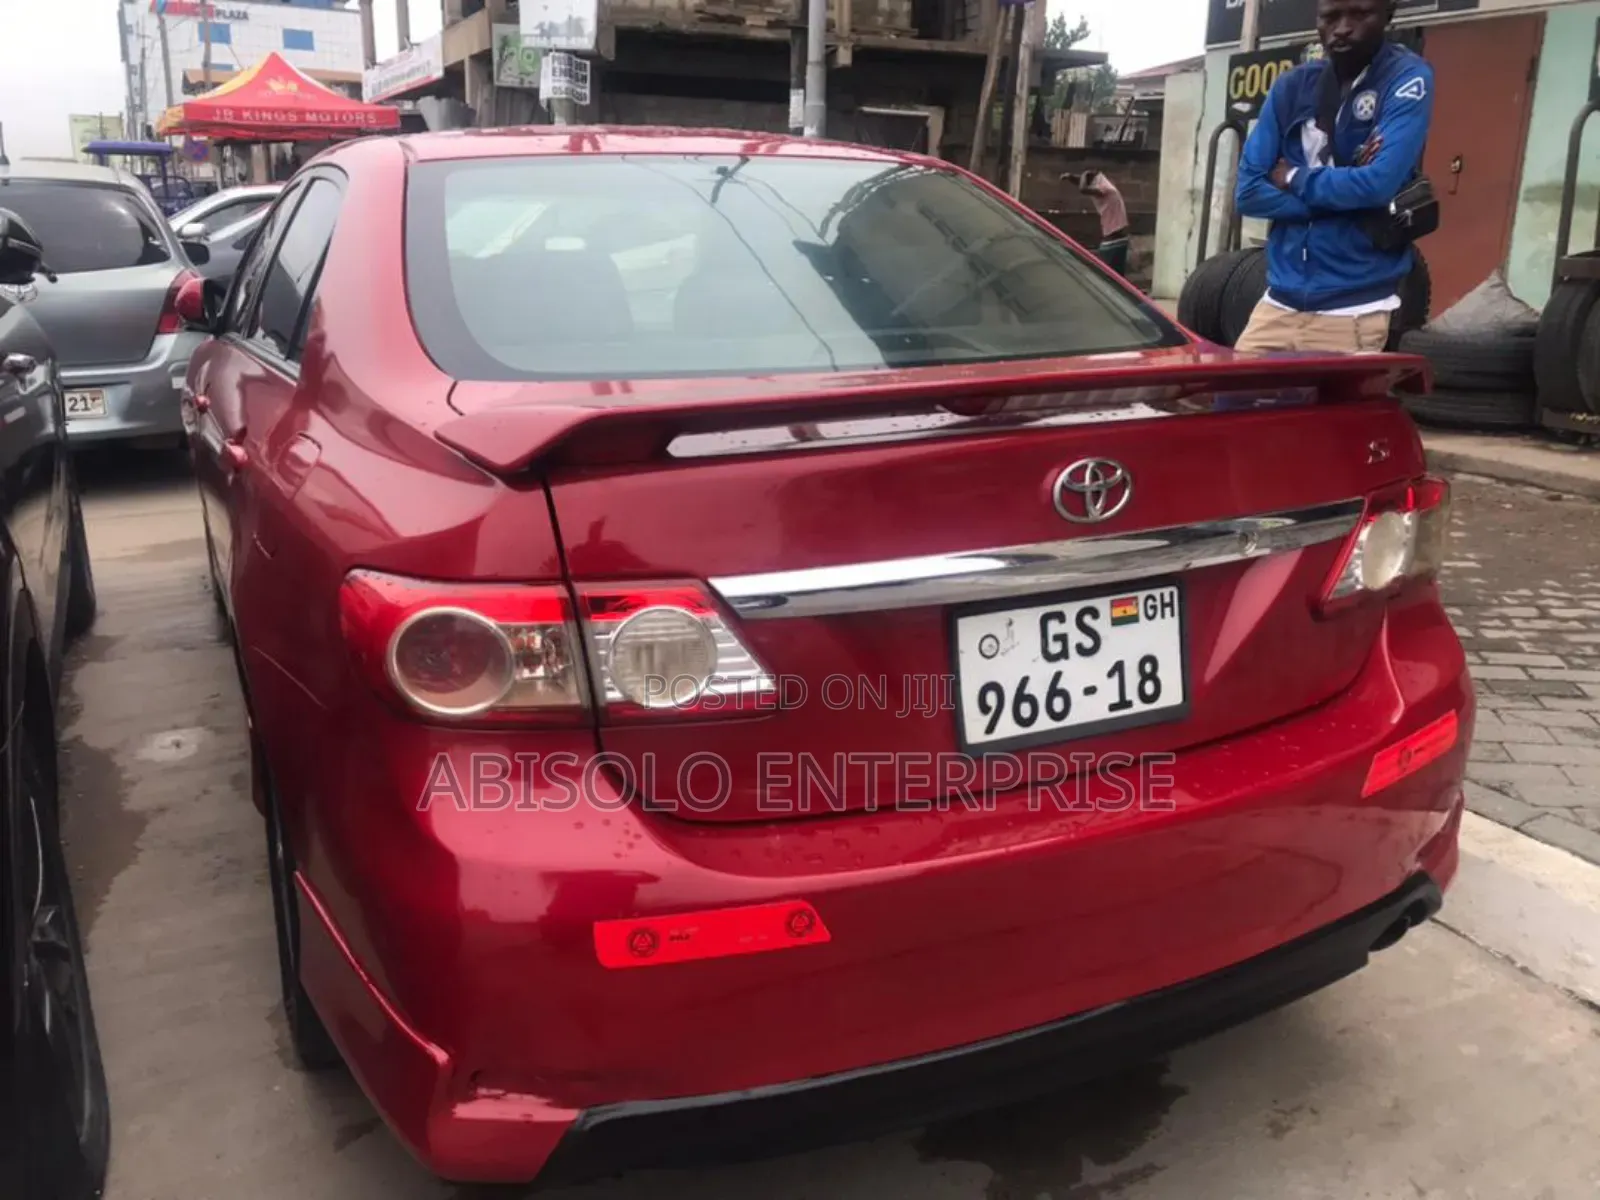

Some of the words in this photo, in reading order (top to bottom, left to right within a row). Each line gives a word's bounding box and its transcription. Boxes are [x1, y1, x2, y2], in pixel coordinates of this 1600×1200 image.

[215, 9, 249, 20] PLAZA
[242, 110, 298, 122] KINGS
[305, 111, 377, 124] MOTORS
[1039, 605, 1101, 663] GS
[1143, 591, 1175, 621] GH
[977, 654, 1162, 735] 966-18
